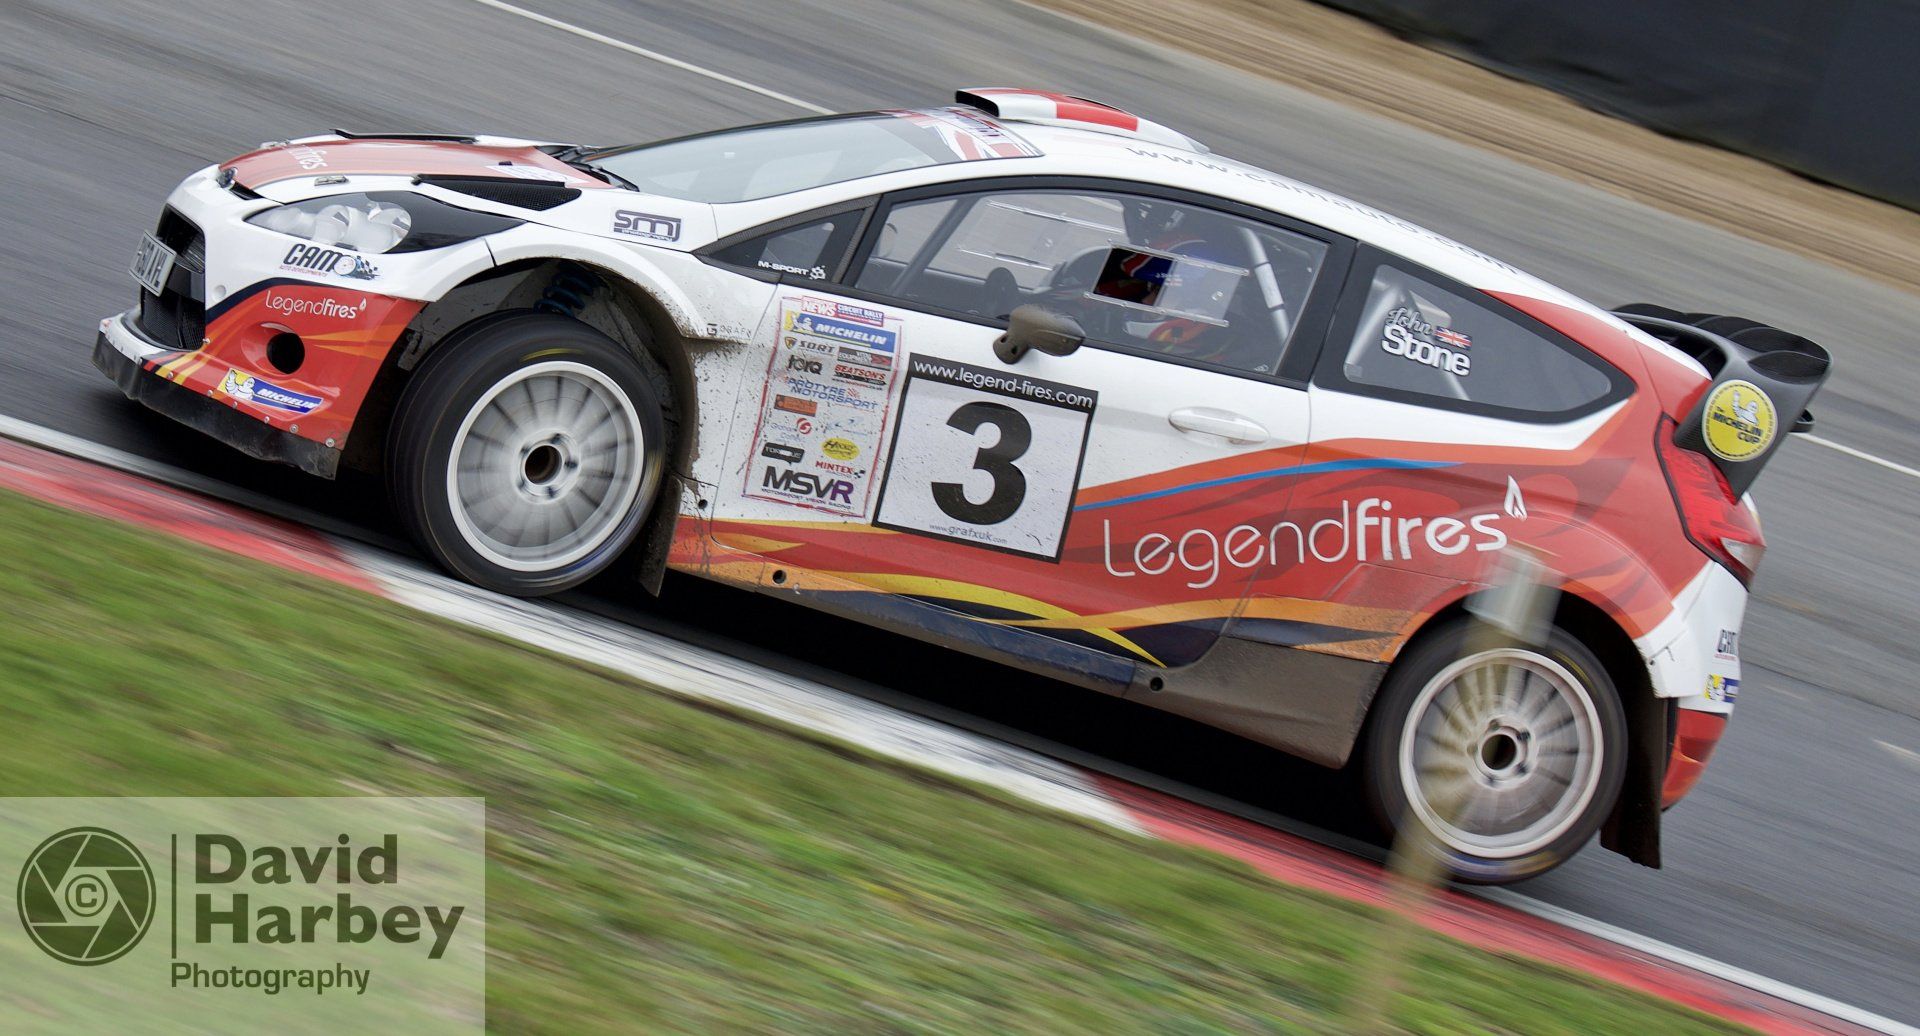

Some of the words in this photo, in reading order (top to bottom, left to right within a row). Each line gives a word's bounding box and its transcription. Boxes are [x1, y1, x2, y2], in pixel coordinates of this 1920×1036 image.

[758, 260, 809, 276] M-SPORT
[265, 290, 358, 319] Legendfires
[802, 302, 836, 318] NEWS
[816, 323, 887, 345] MICHELIN
[1382, 324, 1471, 377] Stone
[914, 360, 1093, 408] www.legend-fires.com
[257, 388, 319, 409] MICHELIN
[791, 387, 878, 409] MOTORSPORT
[816, 460, 854, 475] MINTEX
[931, 401, 1032, 525] 3
[763, 465, 854, 504] MSVR
[1104, 498, 1508, 588] Legendfires
